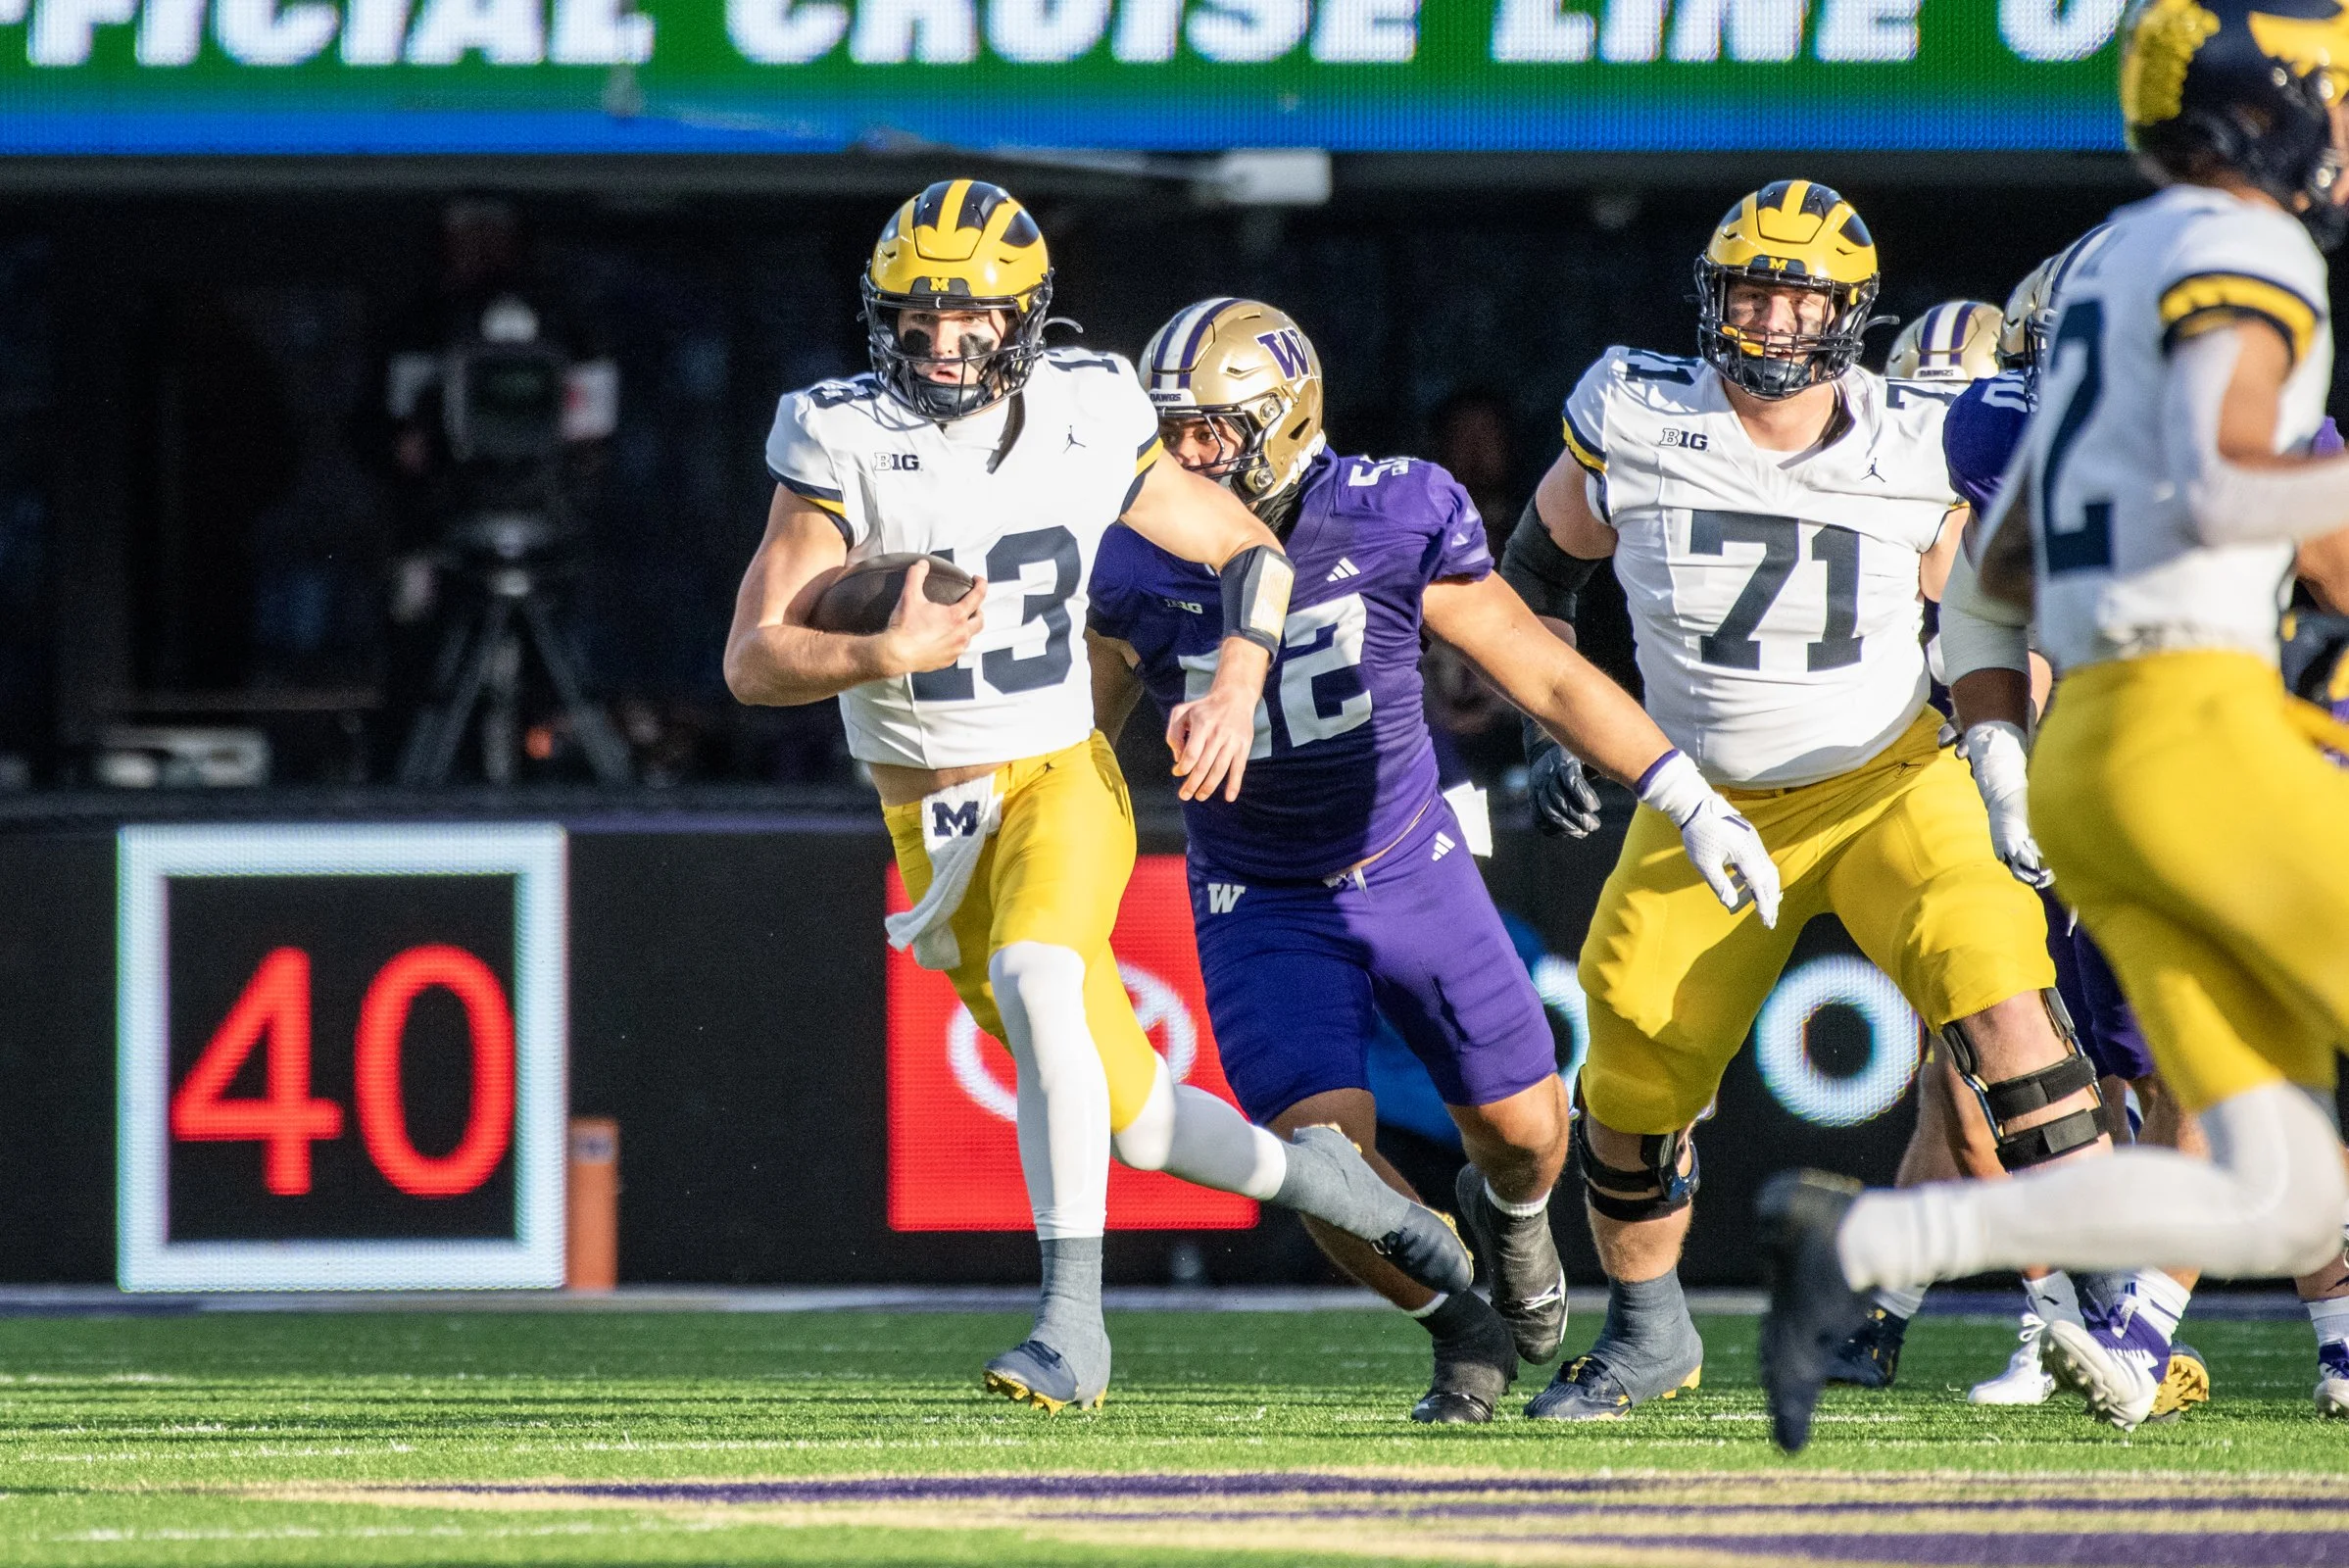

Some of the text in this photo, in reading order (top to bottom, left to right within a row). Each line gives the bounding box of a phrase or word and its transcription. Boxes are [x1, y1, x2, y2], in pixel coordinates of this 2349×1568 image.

[0, 0, 656, 65] FICIAL
[930, 277, 950, 292] M
[1769, 257, 1788, 270] M
[1255, 328, 1311, 380] W
[1689, 509, 1862, 673] 71
[932, 801, 979, 838] M
[1207, 882, 1247, 914] W
[169, 942, 517, 1199] 40
